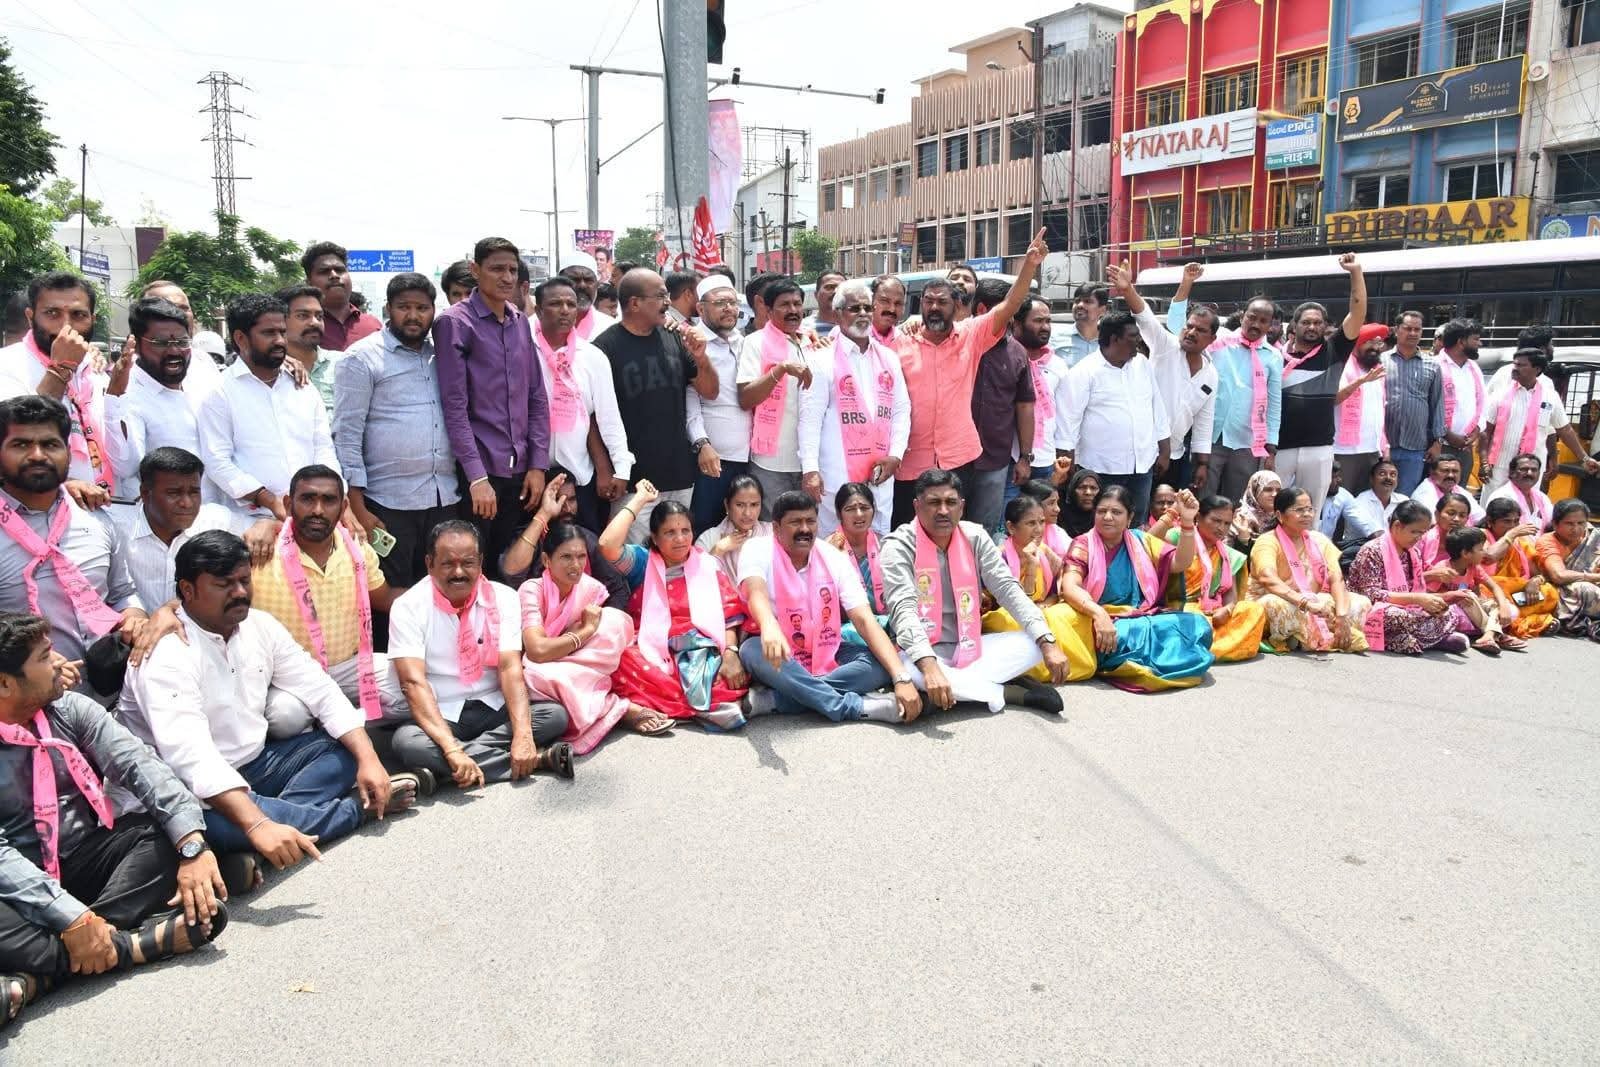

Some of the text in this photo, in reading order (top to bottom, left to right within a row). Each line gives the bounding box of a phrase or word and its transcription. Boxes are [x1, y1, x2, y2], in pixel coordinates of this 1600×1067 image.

[1469, 82, 1487, 94] 150
[1140, 122, 1230, 160] NATARAJ
[1332, 200, 1517, 240] DURBAAR
[841, 411, 867, 424] BRS
